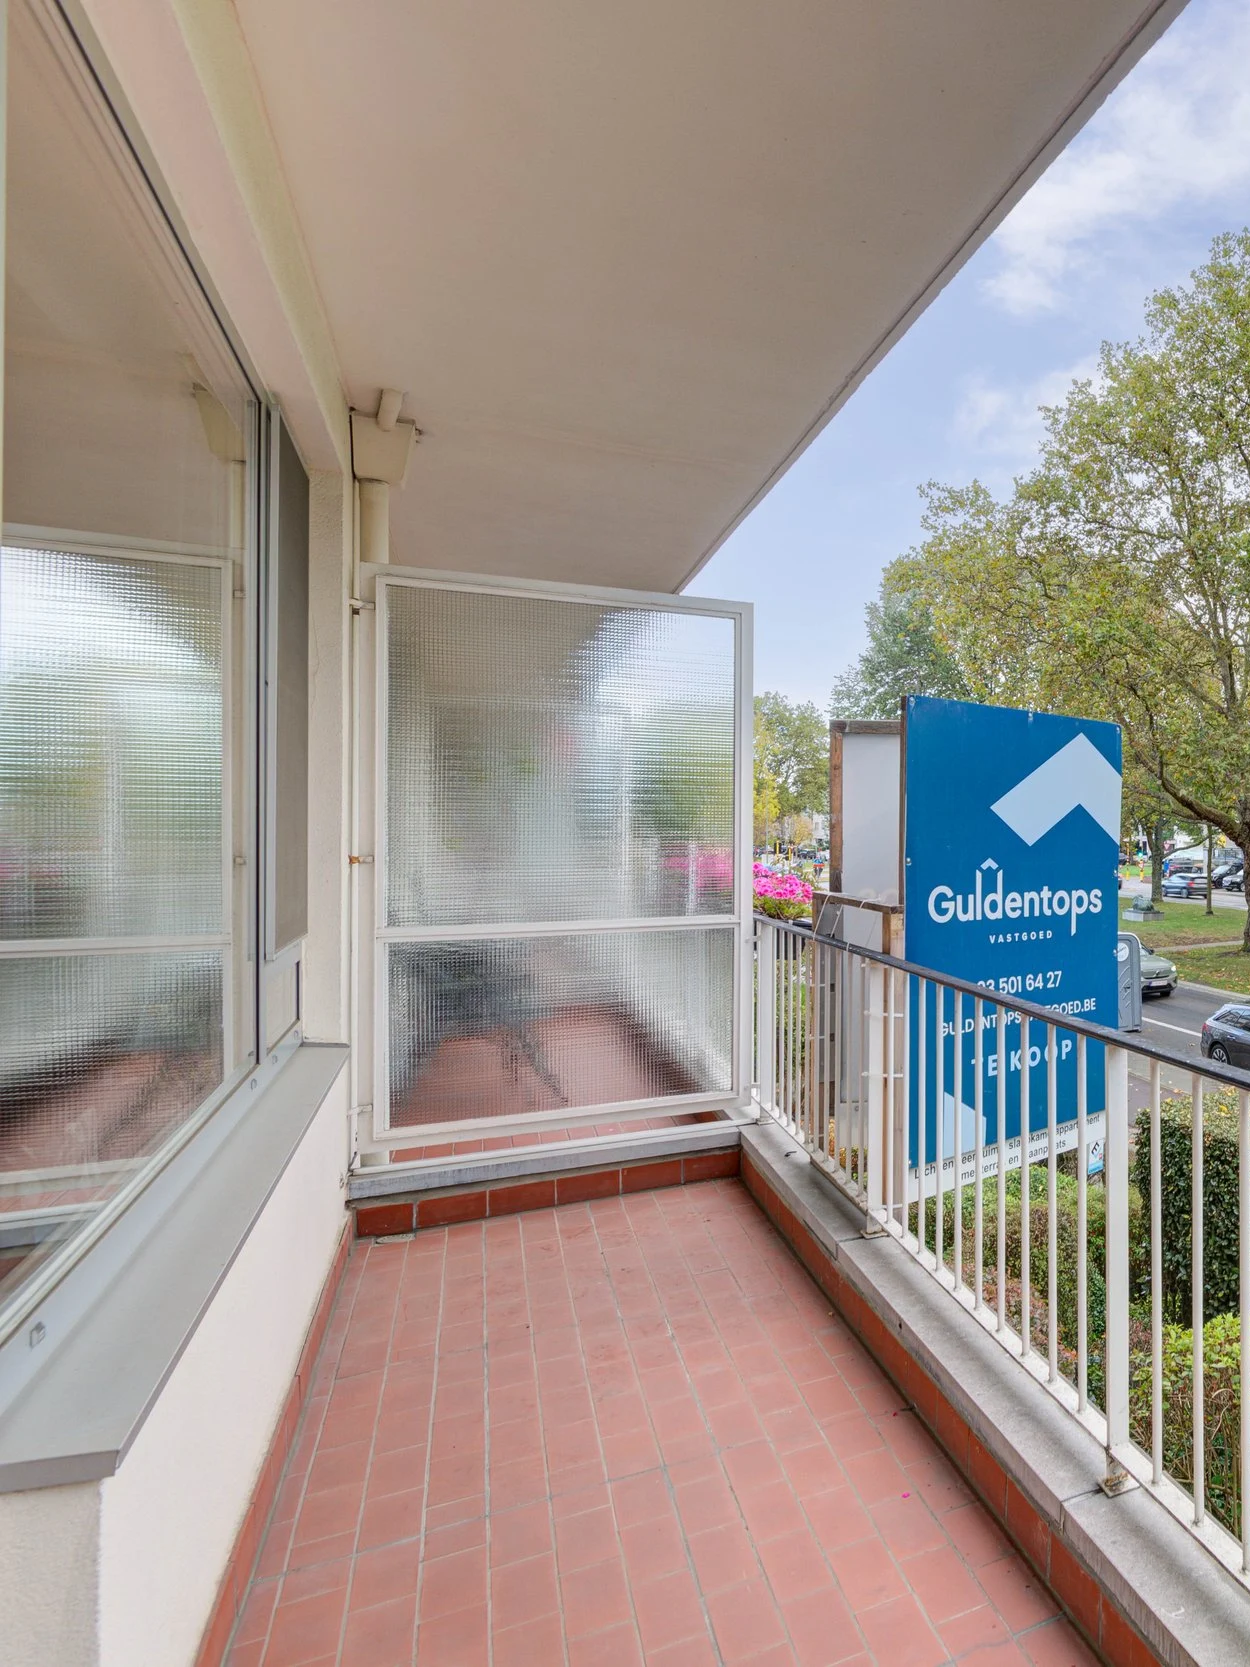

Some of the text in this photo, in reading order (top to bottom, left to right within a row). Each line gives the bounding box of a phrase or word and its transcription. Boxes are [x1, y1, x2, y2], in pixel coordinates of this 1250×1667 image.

[928, 868, 1102, 936] Guldentops
[990, 930, 1053, 944] VASTGOED
[999, 976, 1022, 994] 501
[1026, 973, 1044, 991] 64
[1047, 971, 1062, 988] 27
[982, 1146, 998, 1158] uim
[961, 1169, 975, 1180] me
[1008, 1155, 1019, 1165] en
